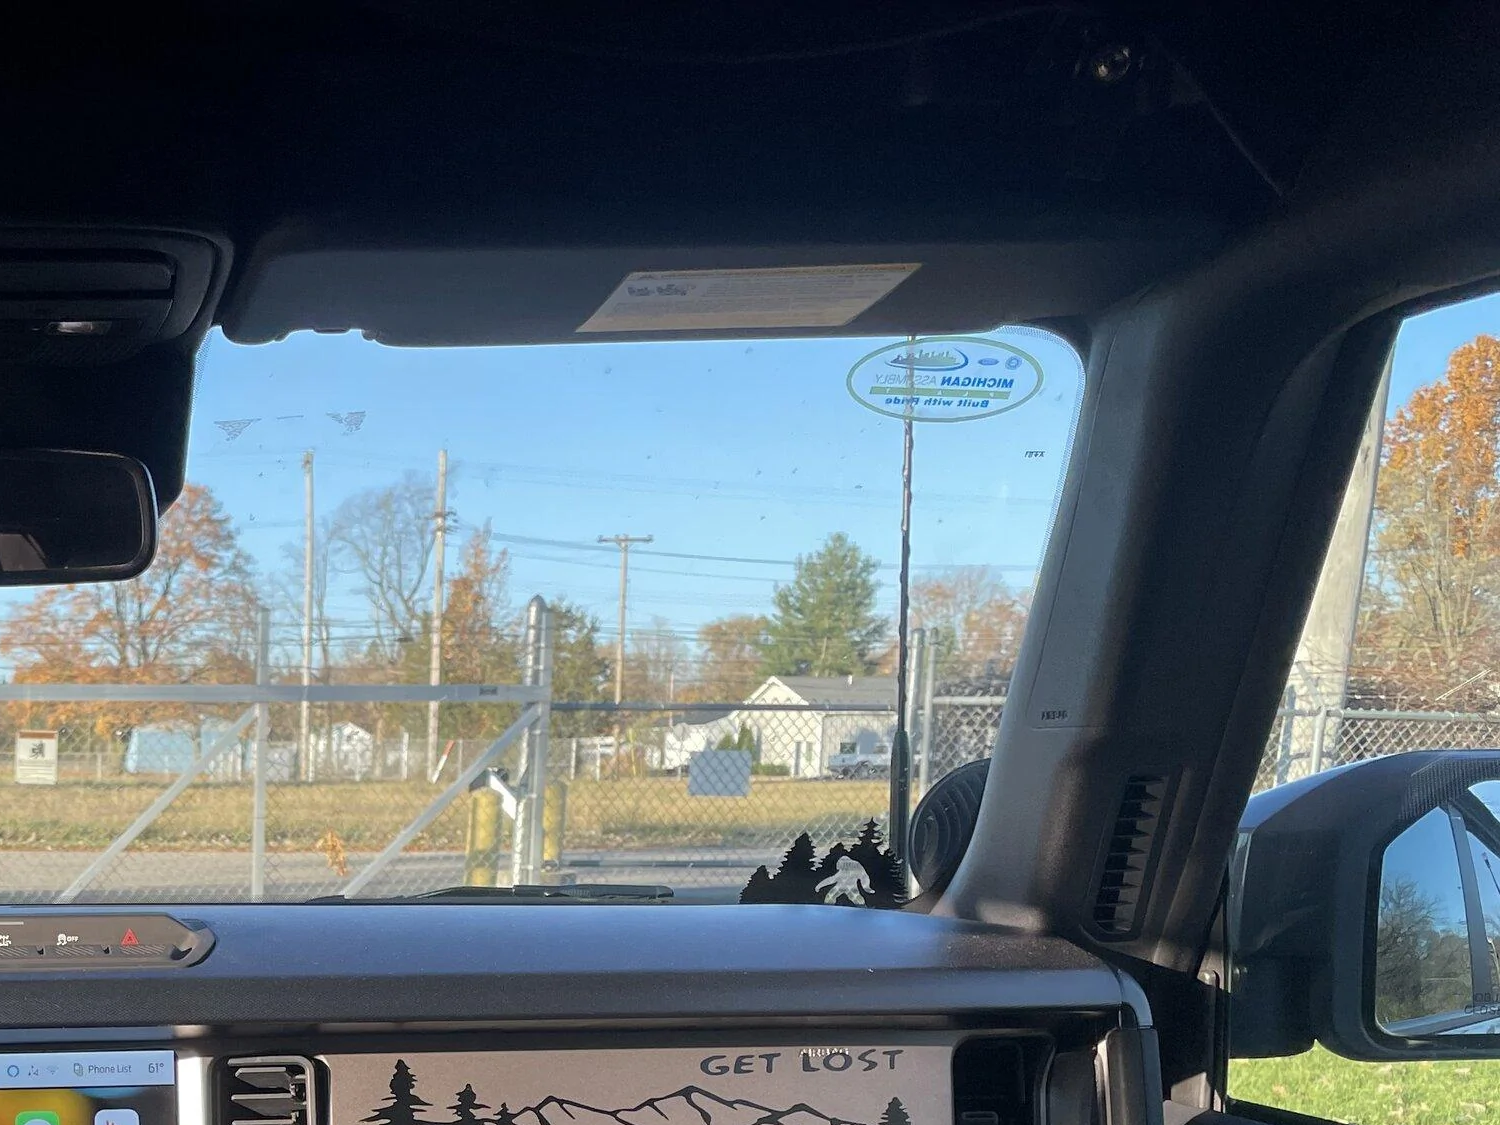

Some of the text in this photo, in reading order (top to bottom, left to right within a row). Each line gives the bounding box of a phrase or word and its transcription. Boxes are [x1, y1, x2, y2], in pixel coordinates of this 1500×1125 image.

[88, 1064, 132, 1074] Phone List
[700, 1049, 904, 1075] GET LOST
